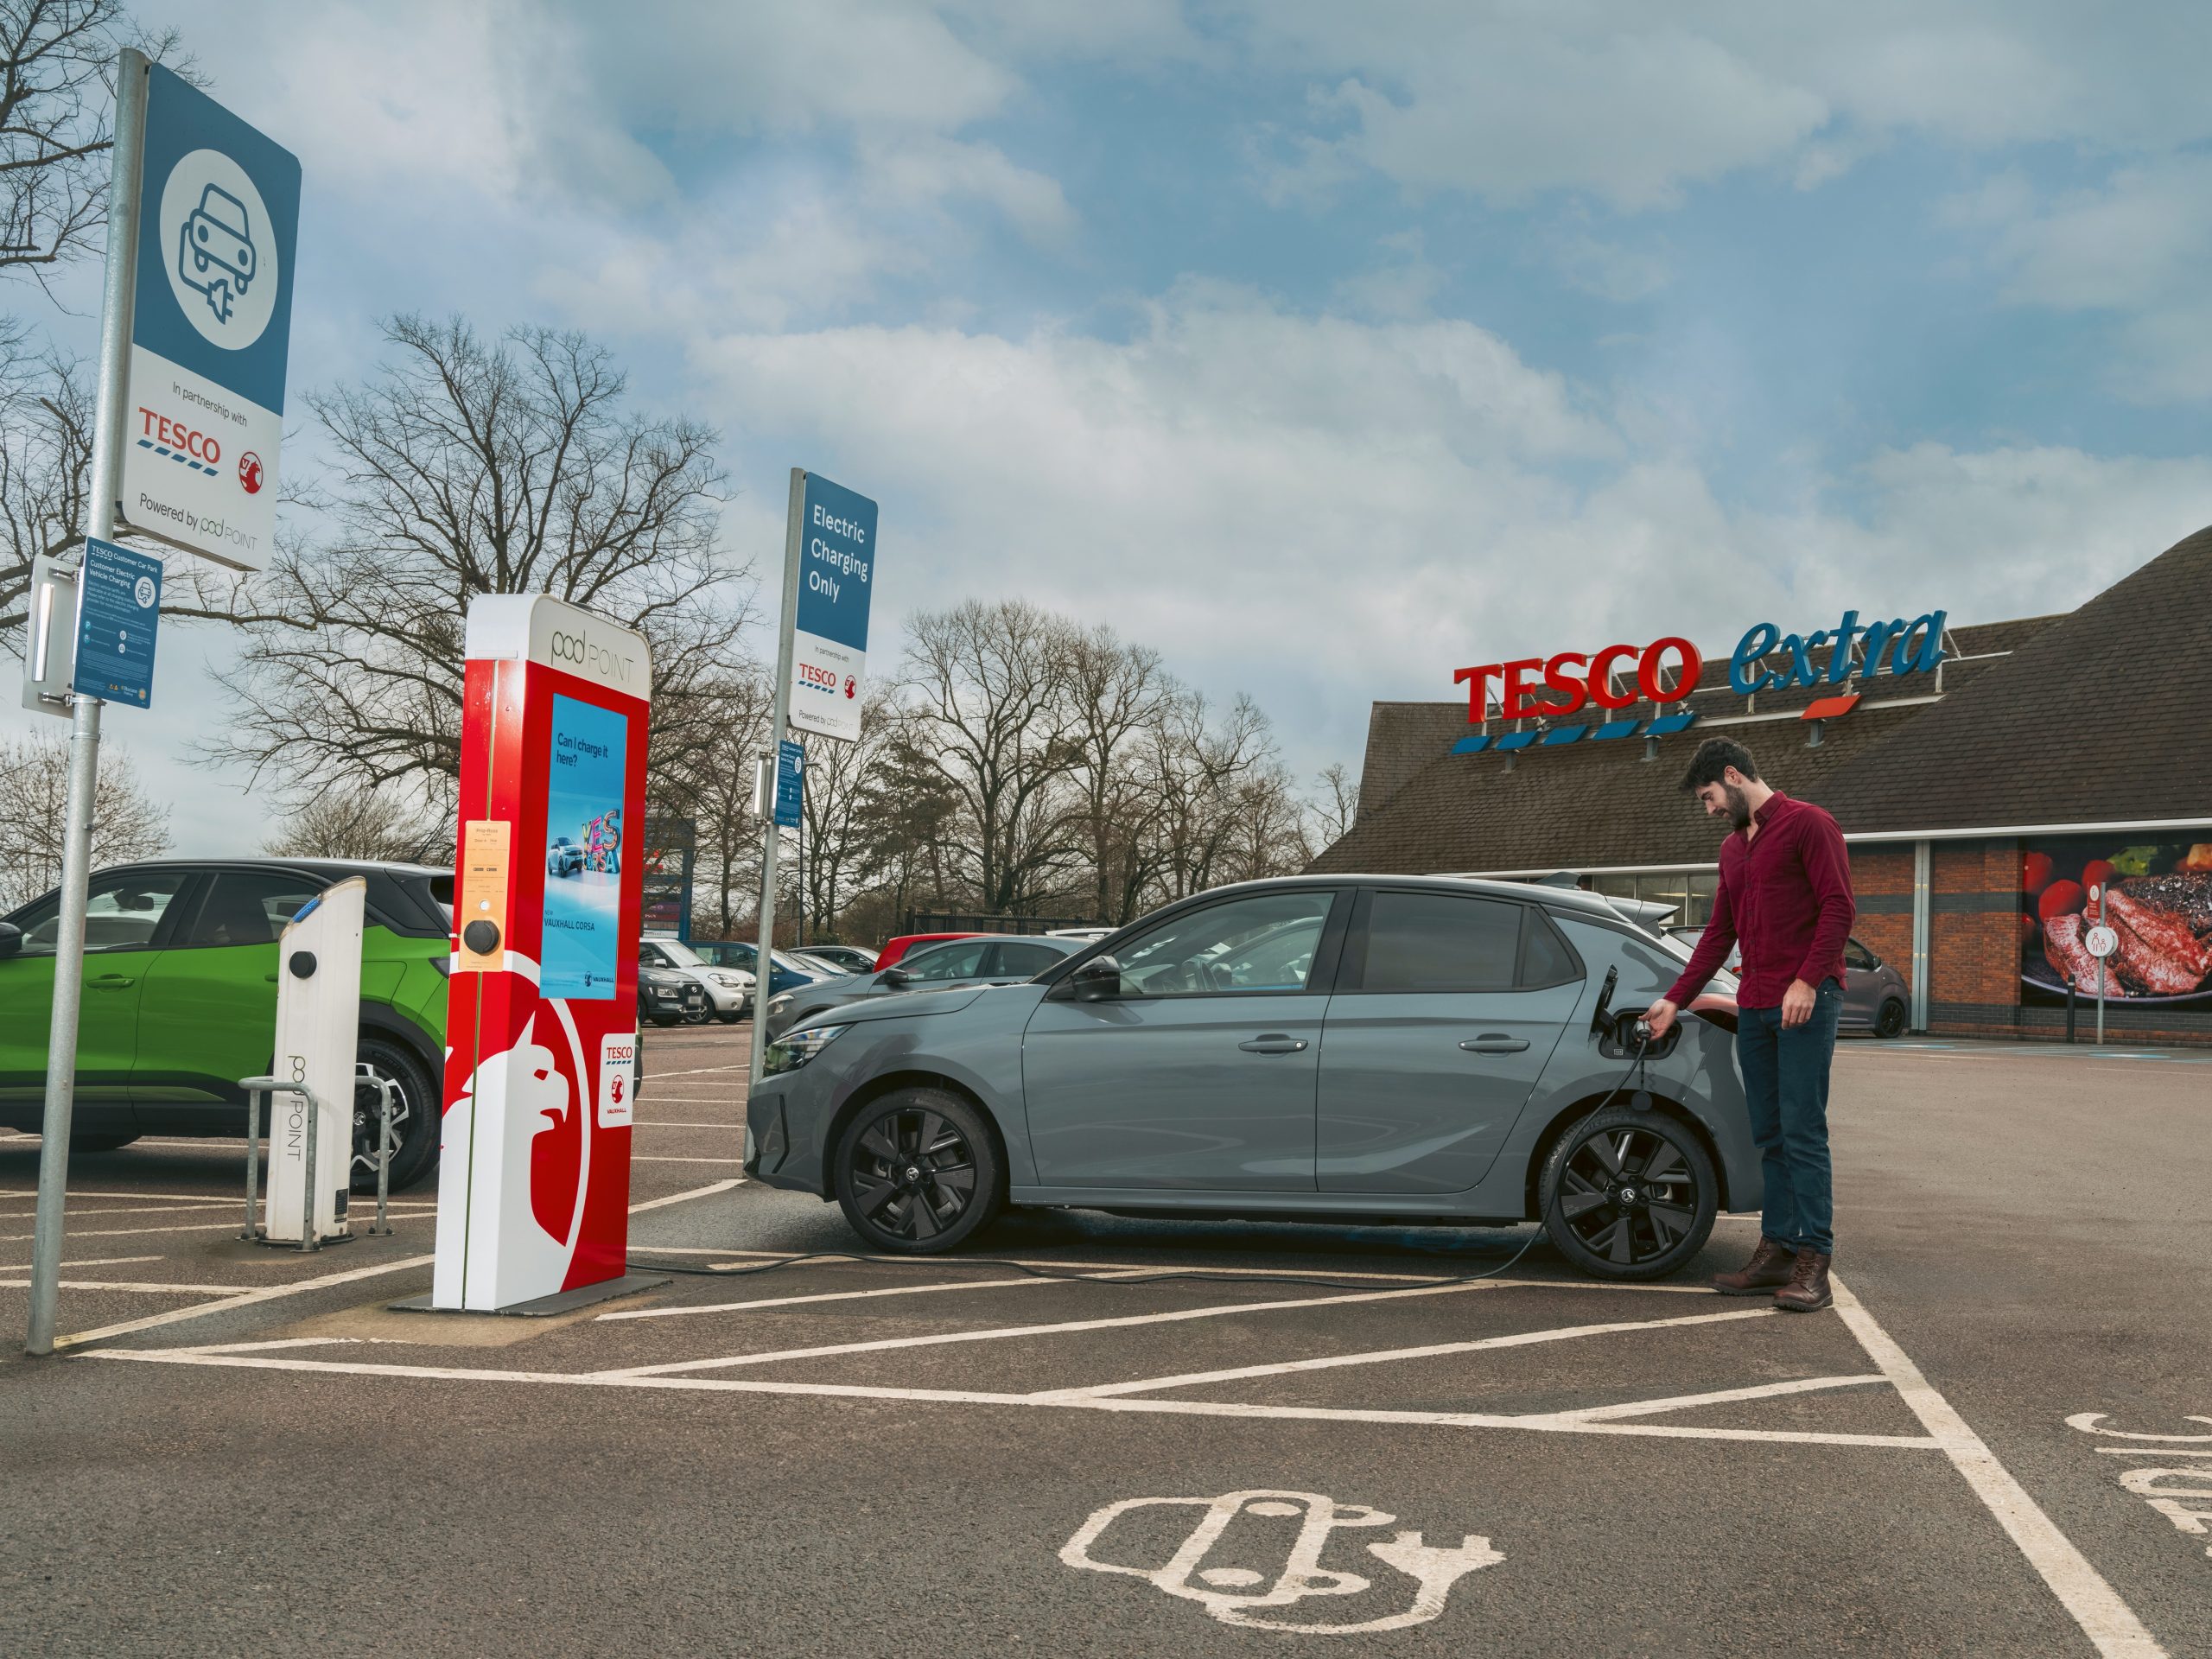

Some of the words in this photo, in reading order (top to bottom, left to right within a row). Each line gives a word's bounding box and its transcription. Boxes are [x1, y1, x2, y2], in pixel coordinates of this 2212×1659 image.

[173, 381, 181, 395] In
[182, 387, 229, 420] partnership
[231, 411, 248, 427] with
[138, 406, 221, 464] TESCO
[139, 493, 184, 522] Powered
[187, 512, 199, 531] by
[200, 518, 225, 537] pod
[225, 526, 258, 550] POINT
[813, 503, 865, 543] Electric
[90, 559, 116, 573] Customer
[116, 568, 136, 580] Electric
[92, 545, 113, 558] TESCO
[113, 553, 137, 566] Customer
[137, 561, 146, 569] Car
[147, 564, 158, 574] Park
[810, 537, 868, 582] Charging
[89, 568, 108, 580] Vehicle
[108, 575, 130, 589] Charging
[809, 570, 840, 603] Only
[550, 629, 586, 666] pod
[588, 644, 634, 683] POINT
[819, 648, 841, 660] partnership
[1453, 636, 1703, 724] TESCO
[1729, 609, 1948, 696] extra
[799, 663, 836, 687] TESCO
[798, 709, 820, 723] Powered
[820, 717, 826, 726] by
[556, 749, 578, 767] here?
[557, 732, 573, 748] Can
[577, 739, 602, 760] charge
[602, 744, 608, 759] it
[582, 808, 620, 853] YES
[543, 918, 575, 930] VAUXHALL
[575, 920, 595, 931] CORSA
[607, 1046, 632, 1058] TESCO
[287, 1100, 303, 1161] POINT
